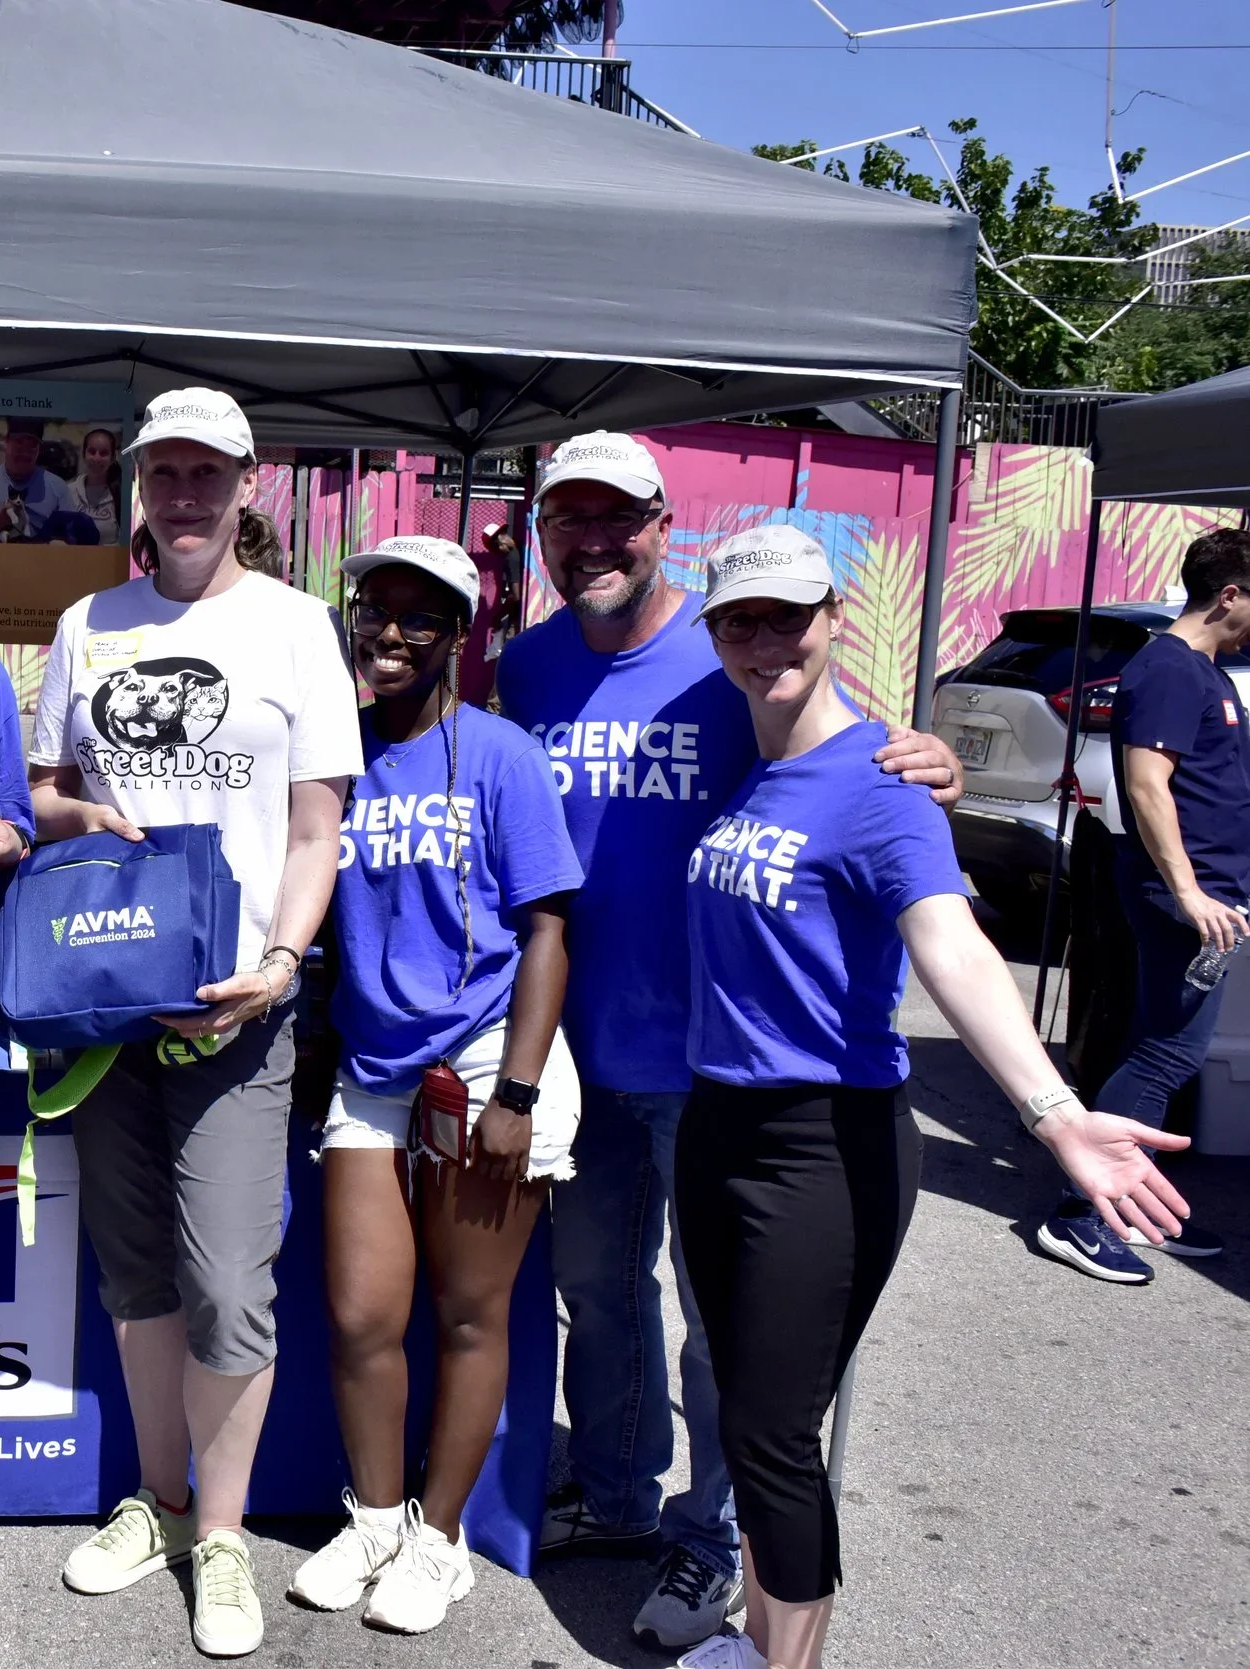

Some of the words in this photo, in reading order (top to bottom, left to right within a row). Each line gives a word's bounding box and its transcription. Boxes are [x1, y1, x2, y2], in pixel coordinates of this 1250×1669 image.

[1, 397, 13, 407] to
[15, 396, 53, 409] Thank
[718, 551, 758, 575] Street
[757, 549, 792, 565] Dog
[723, 560, 781, 578] COALITION
[13, 605, 23, 615] is
[23, 608, 36, 616] on
[37, 608, 44, 616] a
[13, 619, 58, 628] nutrition
[81, 736, 97, 747] The
[76, 743, 168, 777] Street
[172, 743, 255, 789] Dog
[584, 760, 709, 801] THAT.
[340, 793, 476, 833] IENCE
[699, 815, 810, 869] CIENCE
[709, 851, 799, 912] THAT.
[68, 906, 154, 936] AVMA
[69, 931, 129, 947] Convention
[130, 928, 156, 940] 2024
